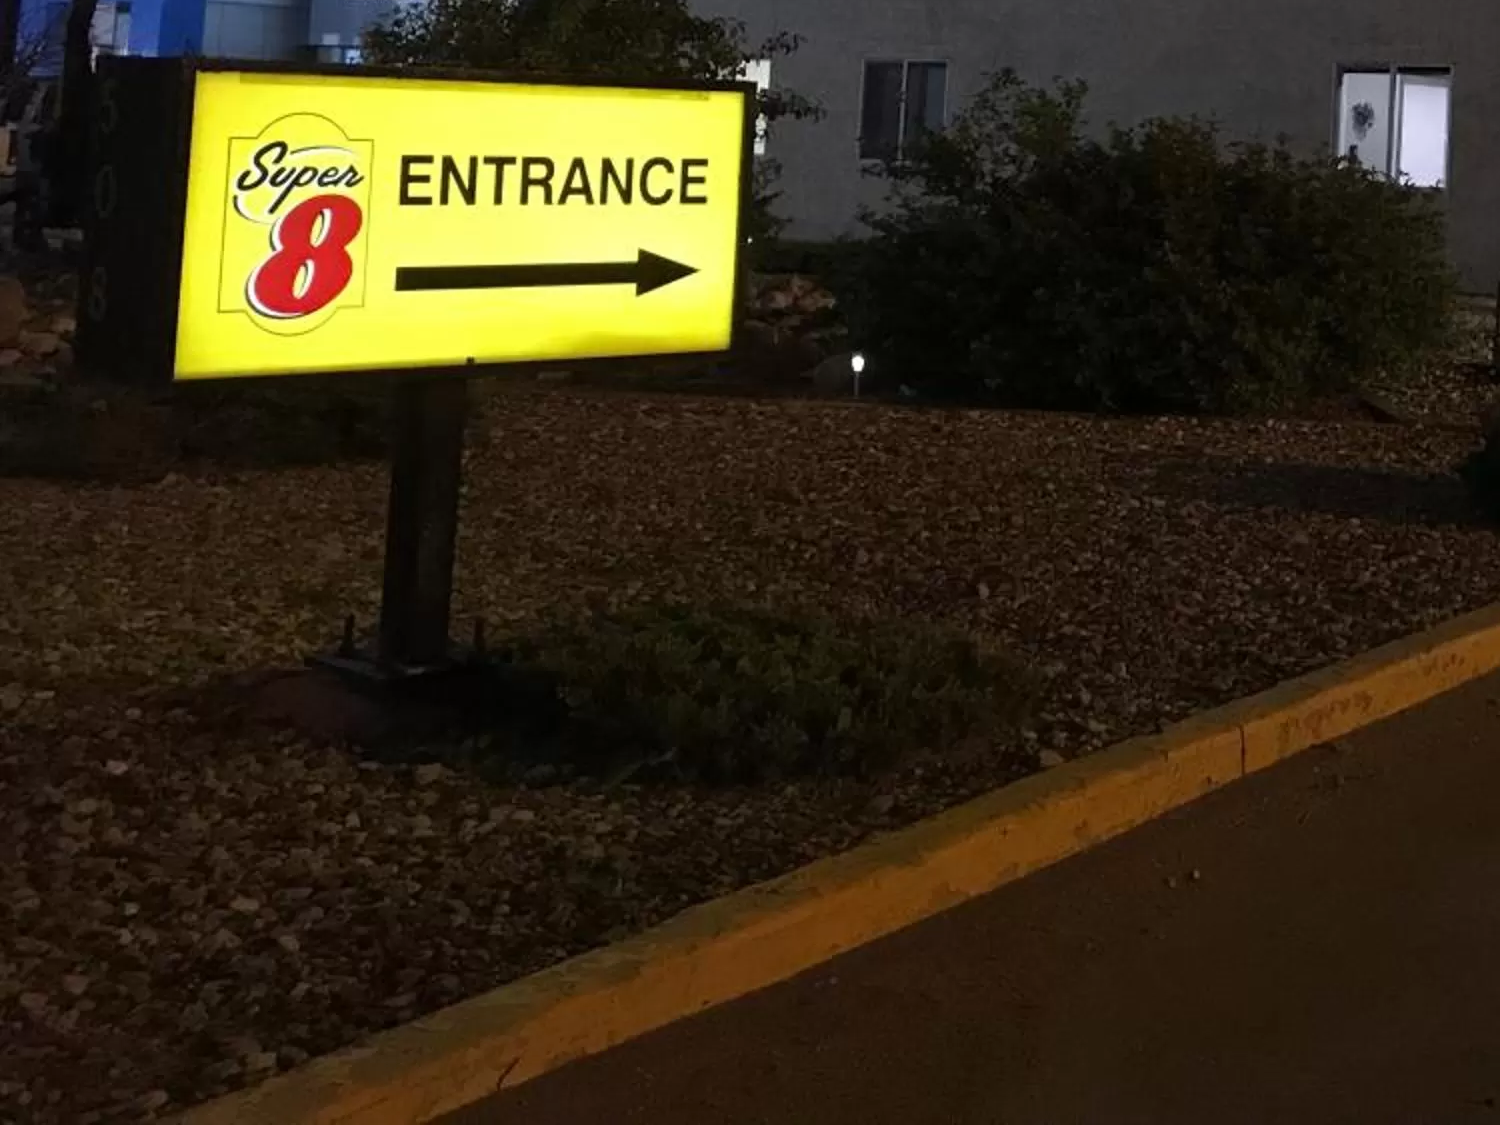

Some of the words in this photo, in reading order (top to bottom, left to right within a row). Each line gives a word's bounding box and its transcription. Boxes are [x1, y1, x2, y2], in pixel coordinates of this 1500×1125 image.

[236, 140, 364, 215] Super
[398, 155, 709, 206] ENTRANCE
[245, 193, 363, 319] 8
